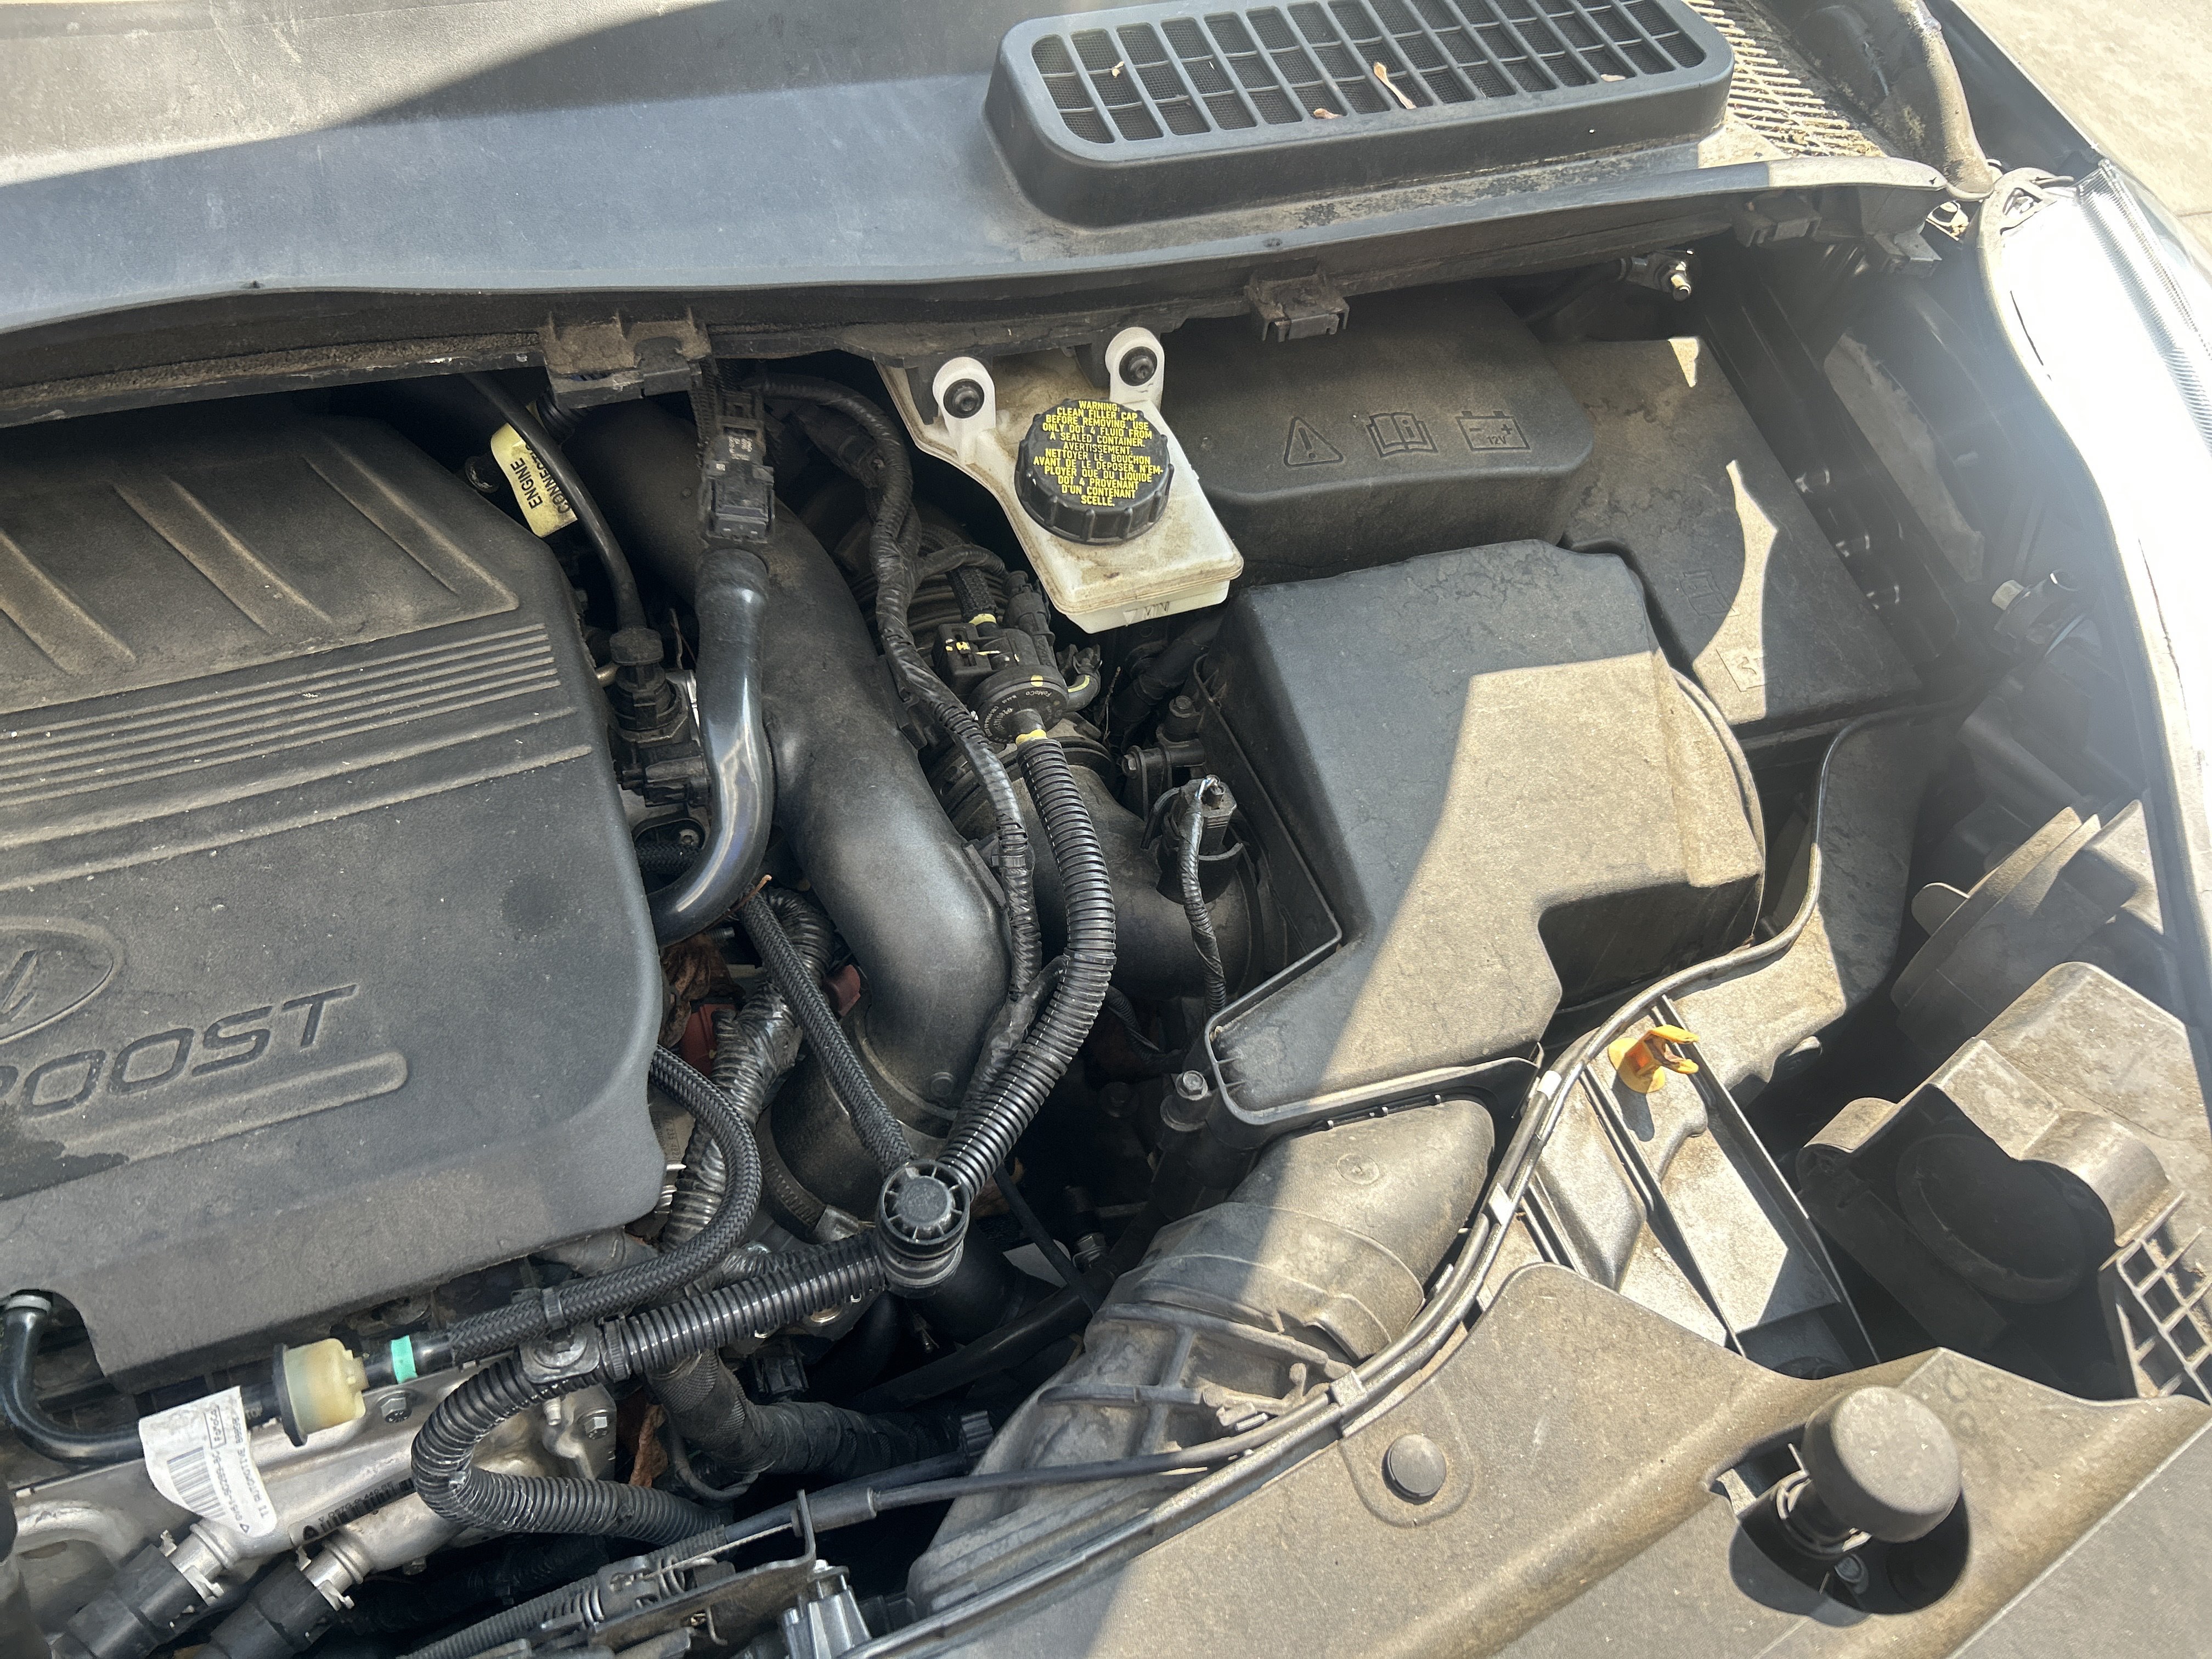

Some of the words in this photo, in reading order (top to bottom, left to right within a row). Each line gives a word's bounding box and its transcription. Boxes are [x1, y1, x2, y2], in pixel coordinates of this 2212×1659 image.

[1046, 414, 1077, 425] BEFORE
[1082, 417, 1128, 429] REMOVING.
[1132, 422, 1148, 431] USE
[1057, 407, 1084, 417] CLEAN
[1088, 409, 1116, 419] FILLER
[1121, 412, 1138, 421] CAP
[1042, 422, 1064, 432] ONLY
[1101, 427, 1124, 437] FLUID
[1129, 430, 1152, 439] FROM
[1049, 432, 1056, 440] A
[1060, 433, 1092, 443] SEALED
[1097, 436, 1145, 447] CONTAINER.
[1486, 436, 1506, 445] 12V
[1034, 456, 1061, 466] AVANT
[1045, 448, 1088, 460] NETTOYER
[1094, 453, 1103, 461] LE
[1111, 455, 1150, 465] BOUCHON
[1045, 466, 1077, 476] PLOYER
[1082, 470, 1098, 478] QUE
[1119, 472, 1152, 483] LIQUIDE
[1058, 475, 1074, 484] DOT
[1079, 477, 1085, 486] 4
[1089, 478, 1139, 490] PROVENANT
[510, 458, 543, 509] ENGINE
[1062, 484, 1082, 494] D'UN
[1087, 487, 1136, 499] CONTENANT
[0, 984, 358, 1109] OOST
[237, 1447, 261, 1503] AUTOMOTIVE
